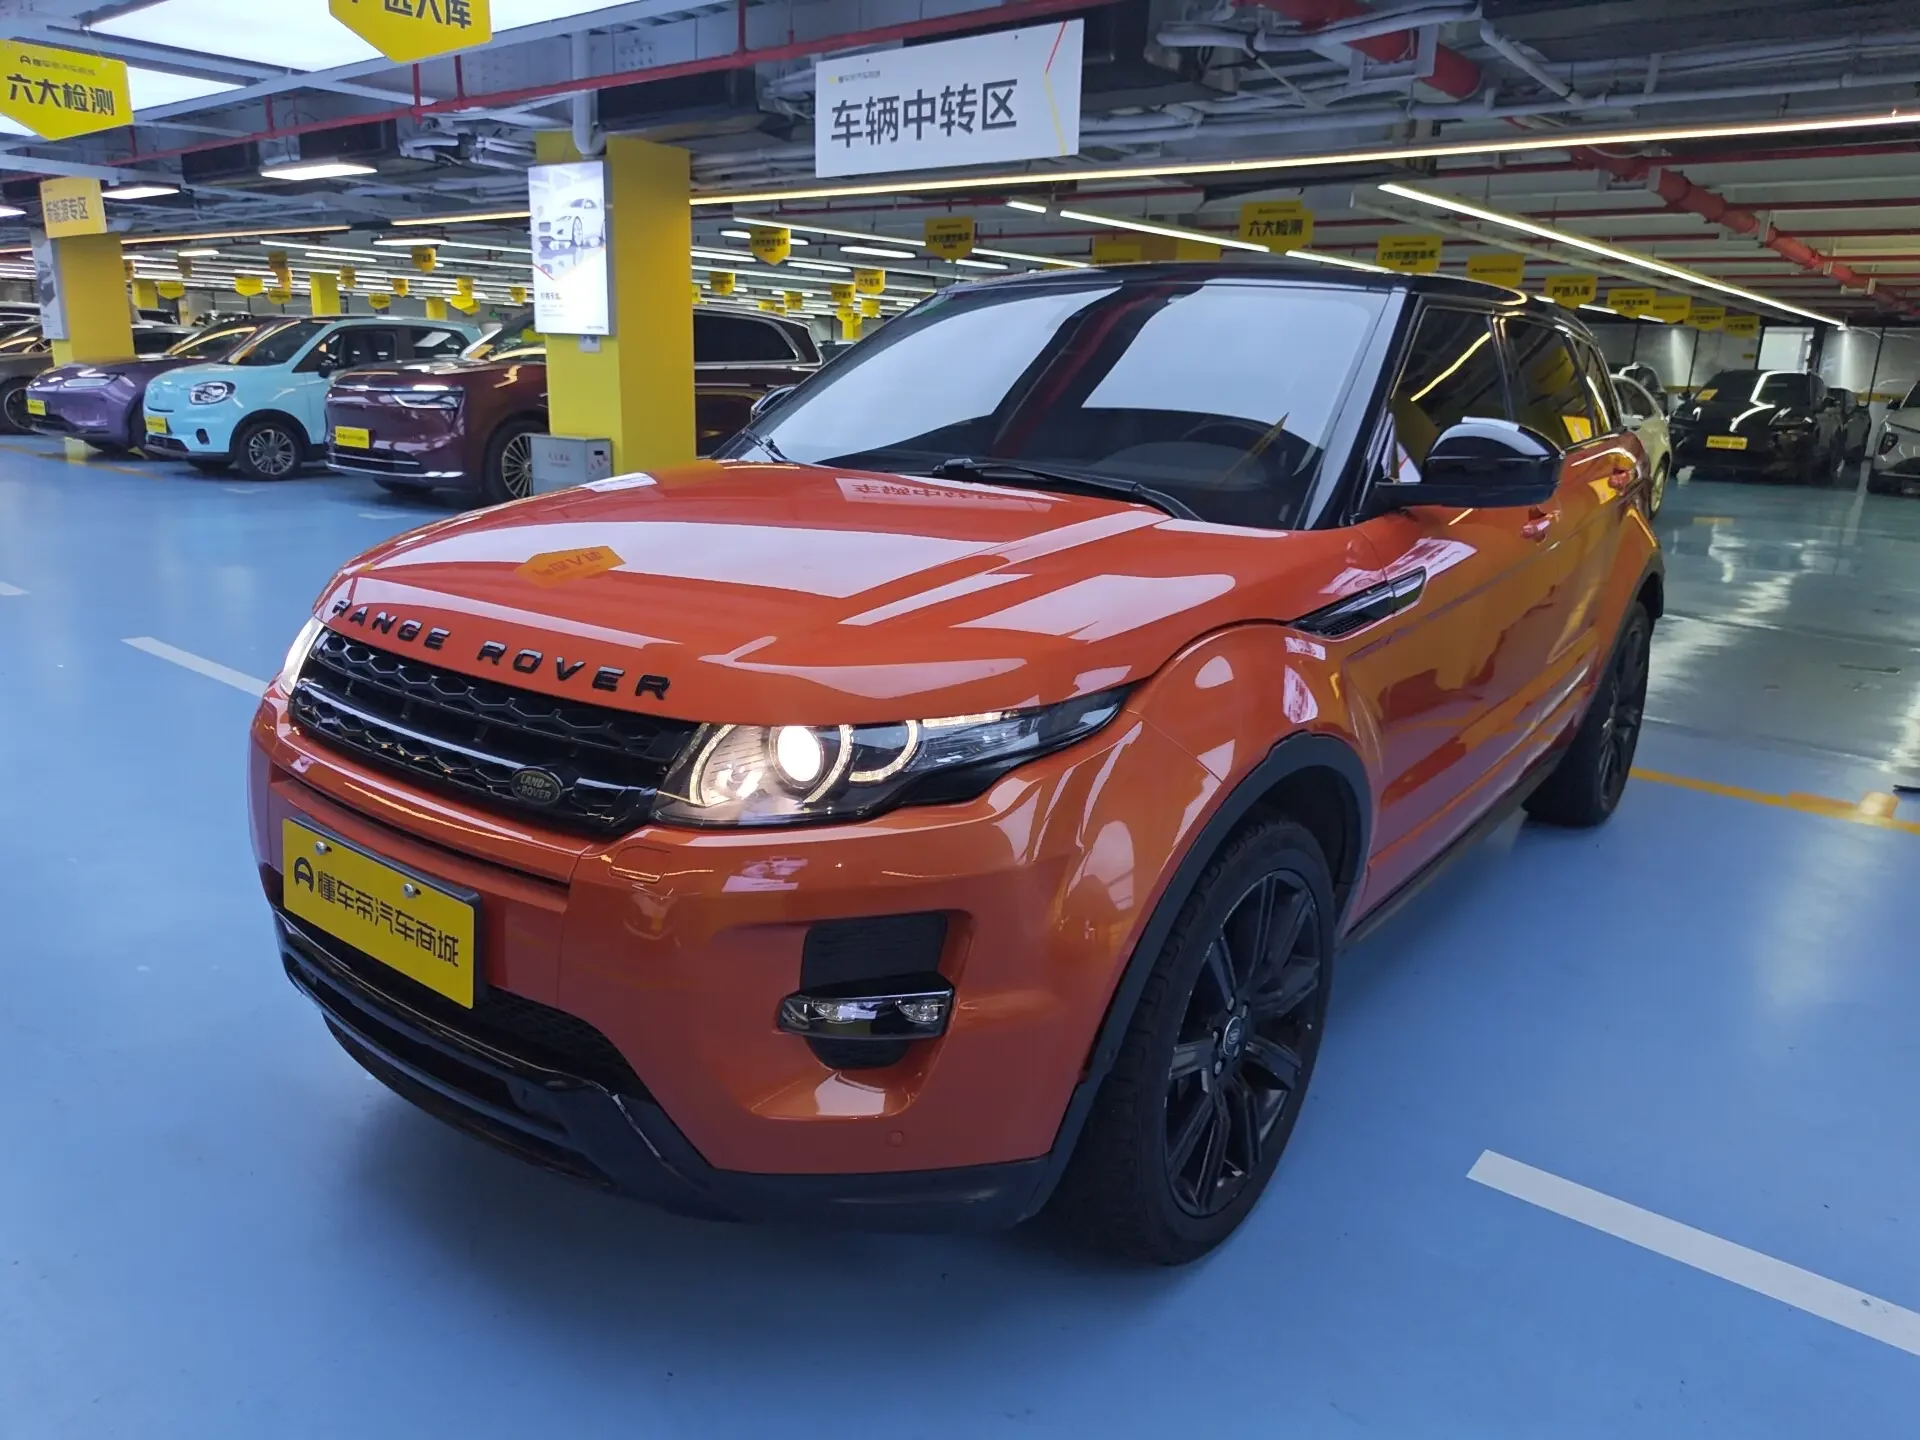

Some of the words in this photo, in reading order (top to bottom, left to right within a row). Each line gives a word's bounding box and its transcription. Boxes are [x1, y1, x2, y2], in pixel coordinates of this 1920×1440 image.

[7, 73, 115, 116] 六大检测
[831, 79, 1018, 148] 车辆中转区
[331, 598, 452, 651] RANGE
[476, 640, 671, 701] ROVER
[520, 773, 545, 788] LAND
[521, 785, 551, 800] ROVER
[317, 870, 459, 968] 懂车帝汽车商城
